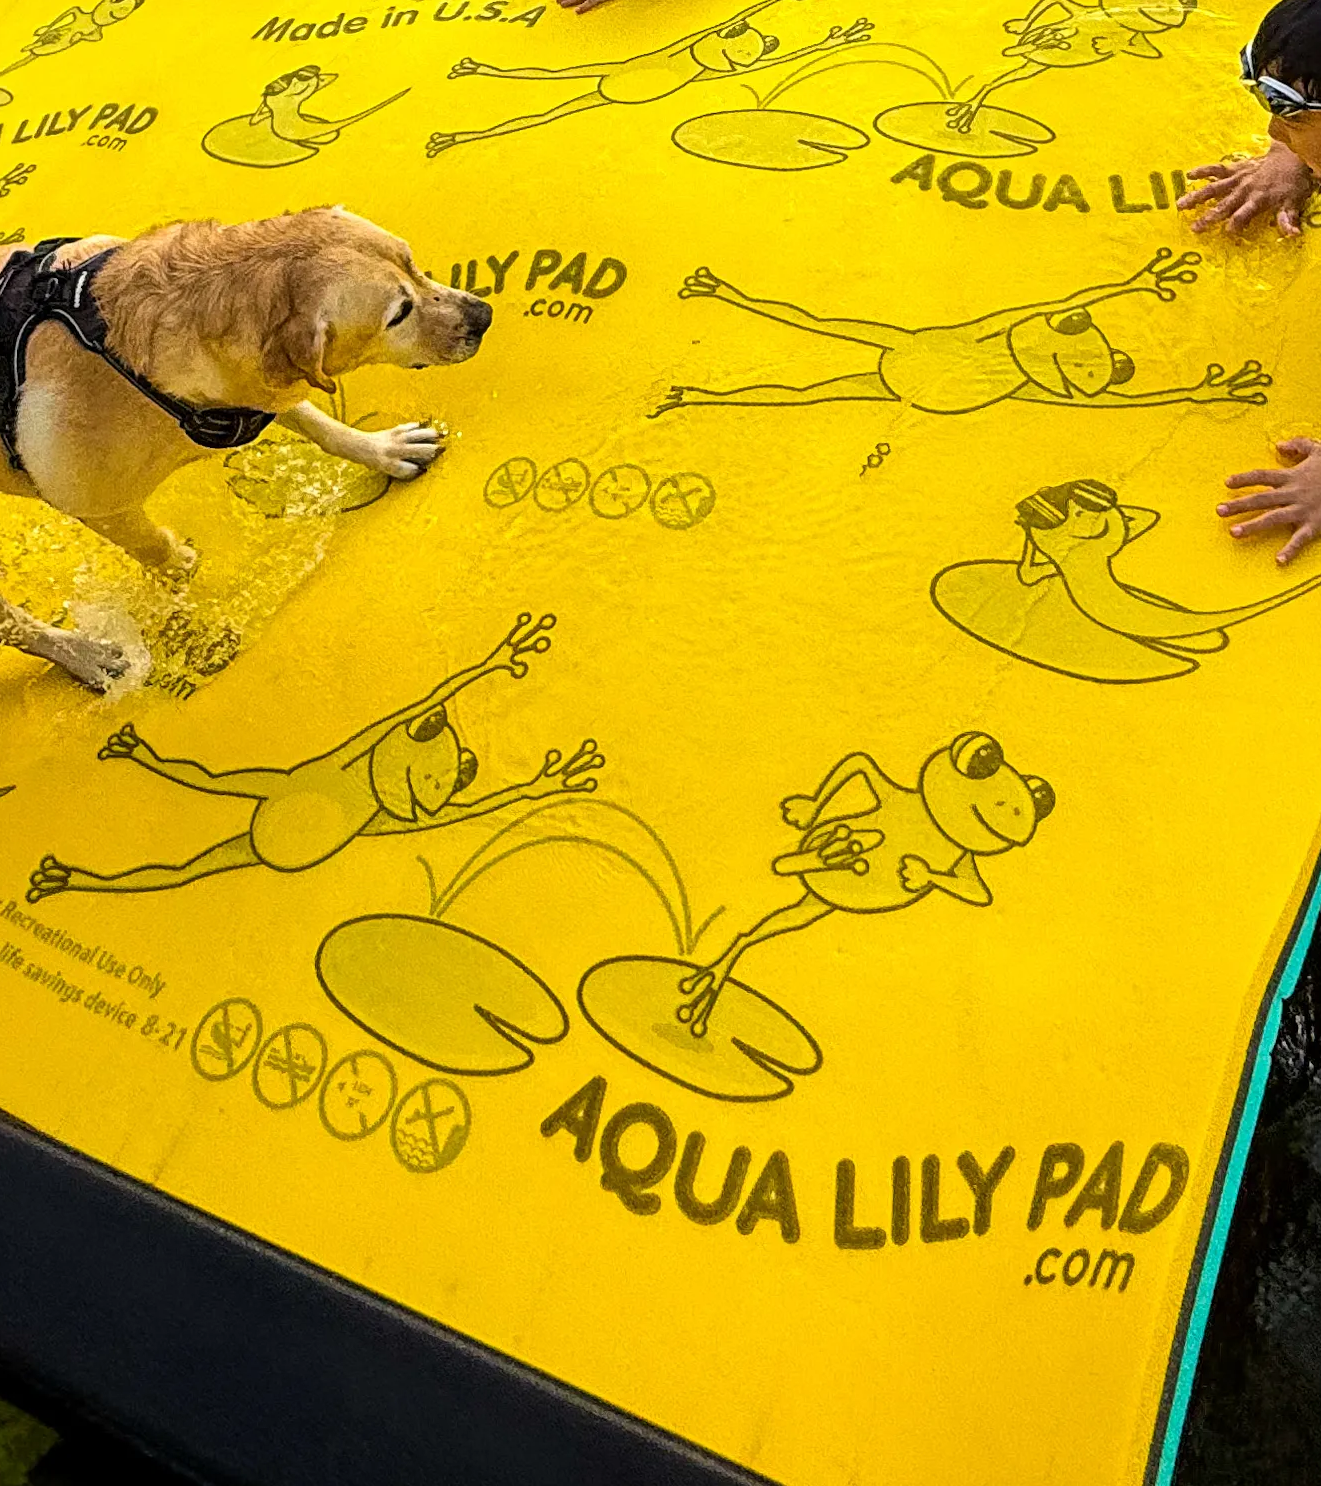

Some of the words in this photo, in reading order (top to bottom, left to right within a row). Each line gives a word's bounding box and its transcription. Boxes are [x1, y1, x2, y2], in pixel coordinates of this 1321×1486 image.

[250, 12, 368, 43] Made
[381, 5, 419, 30] in
[433, 0, 548, 28] U.S.A
[11, 104, 94, 144] LILY
[88, 102, 159, 135] PAD
[80, 133, 127, 153] .com
[890, 154, 1091, 214] AQUA
[424, 250, 519, 298] ILY
[525, 249, 627, 299] PAD
[523, 298, 594, 324] .com
[0, 900, 102, 965] Recreational
[96, 950, 127, 979] Use
[128, 965, 167, 1000] Only
[22, 962, 85, 1003] savings
[84, 990, 137, 1029] device
[540, 1075, 800, 1244] AQUA
[833, 1146, 1016, 1250] LILY
[1026, 1140, 1190, 1235] PAD
[1023, 1247, 1136, 1293] .com
